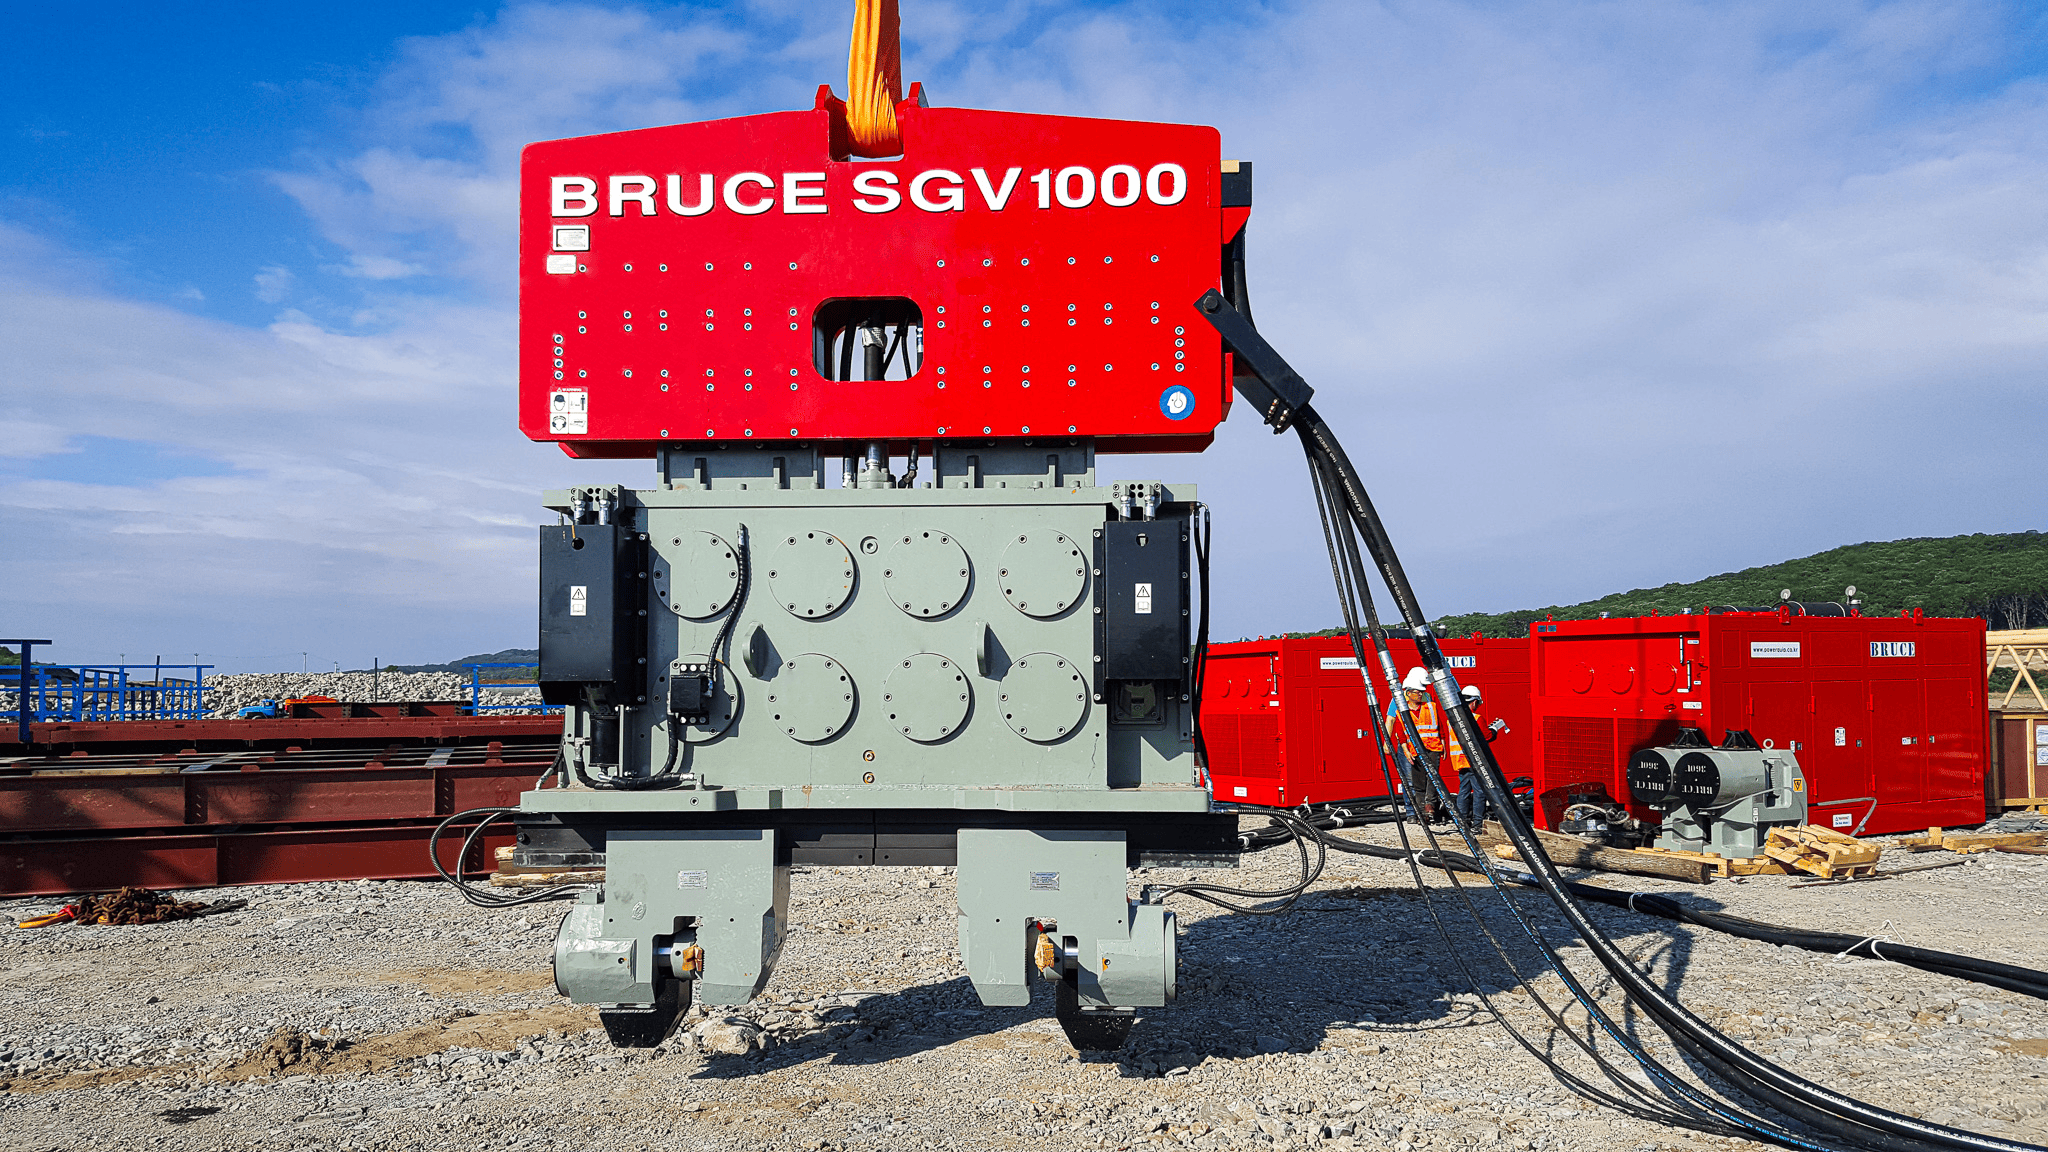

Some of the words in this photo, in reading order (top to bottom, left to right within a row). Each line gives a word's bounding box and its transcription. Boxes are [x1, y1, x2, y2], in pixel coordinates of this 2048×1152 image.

[550, 171, 830, 218] BRUCE
[1870, 641, 1915, 657] BRUCE
[1634, 780, 1664, 791] BRUCE
[1681, 784, 1713, 795] BRUCE
[1521, 840, 1548, 876] ALFAGOMMA
